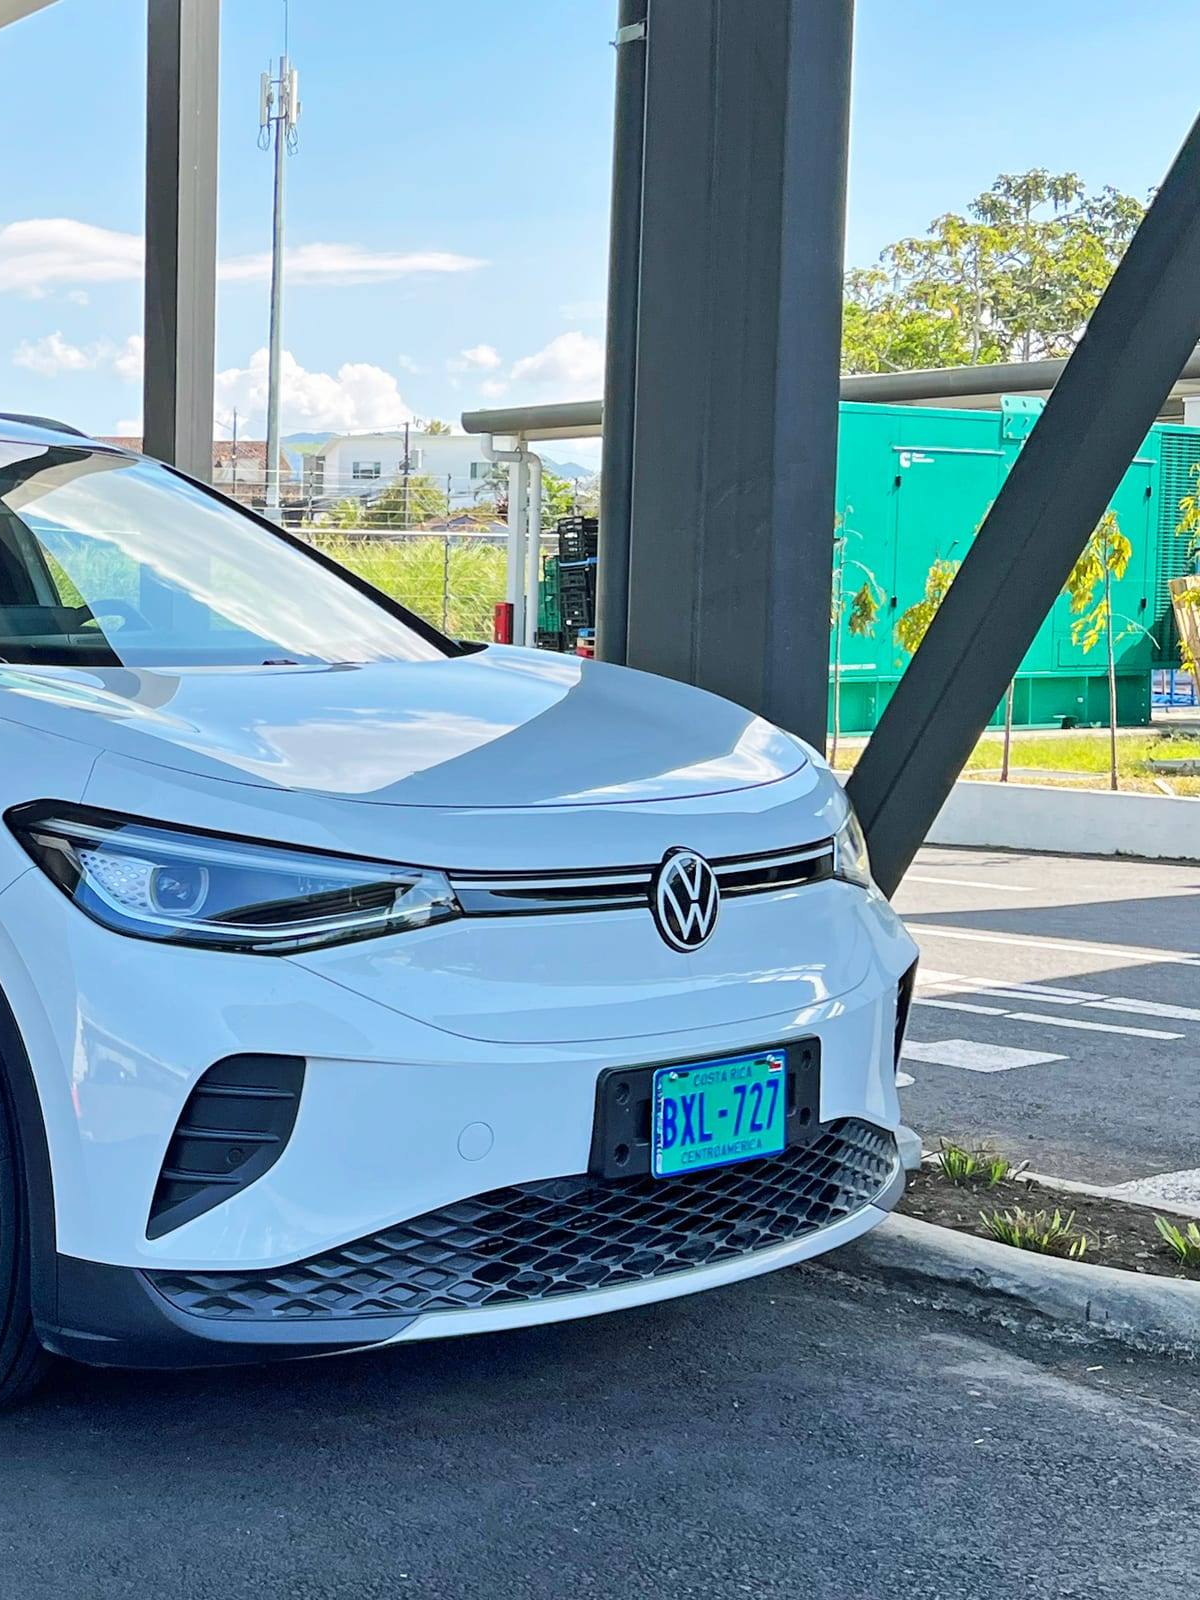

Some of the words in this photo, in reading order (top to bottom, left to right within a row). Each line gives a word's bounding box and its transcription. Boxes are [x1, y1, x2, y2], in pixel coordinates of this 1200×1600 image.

[661, 853, 718, 945] VW
[693, 1071, 728, 1087] COSTA
[729, 1065, 753, 1081] RICA
[680, 1137, 763, 1165] CENTROAMERICA
